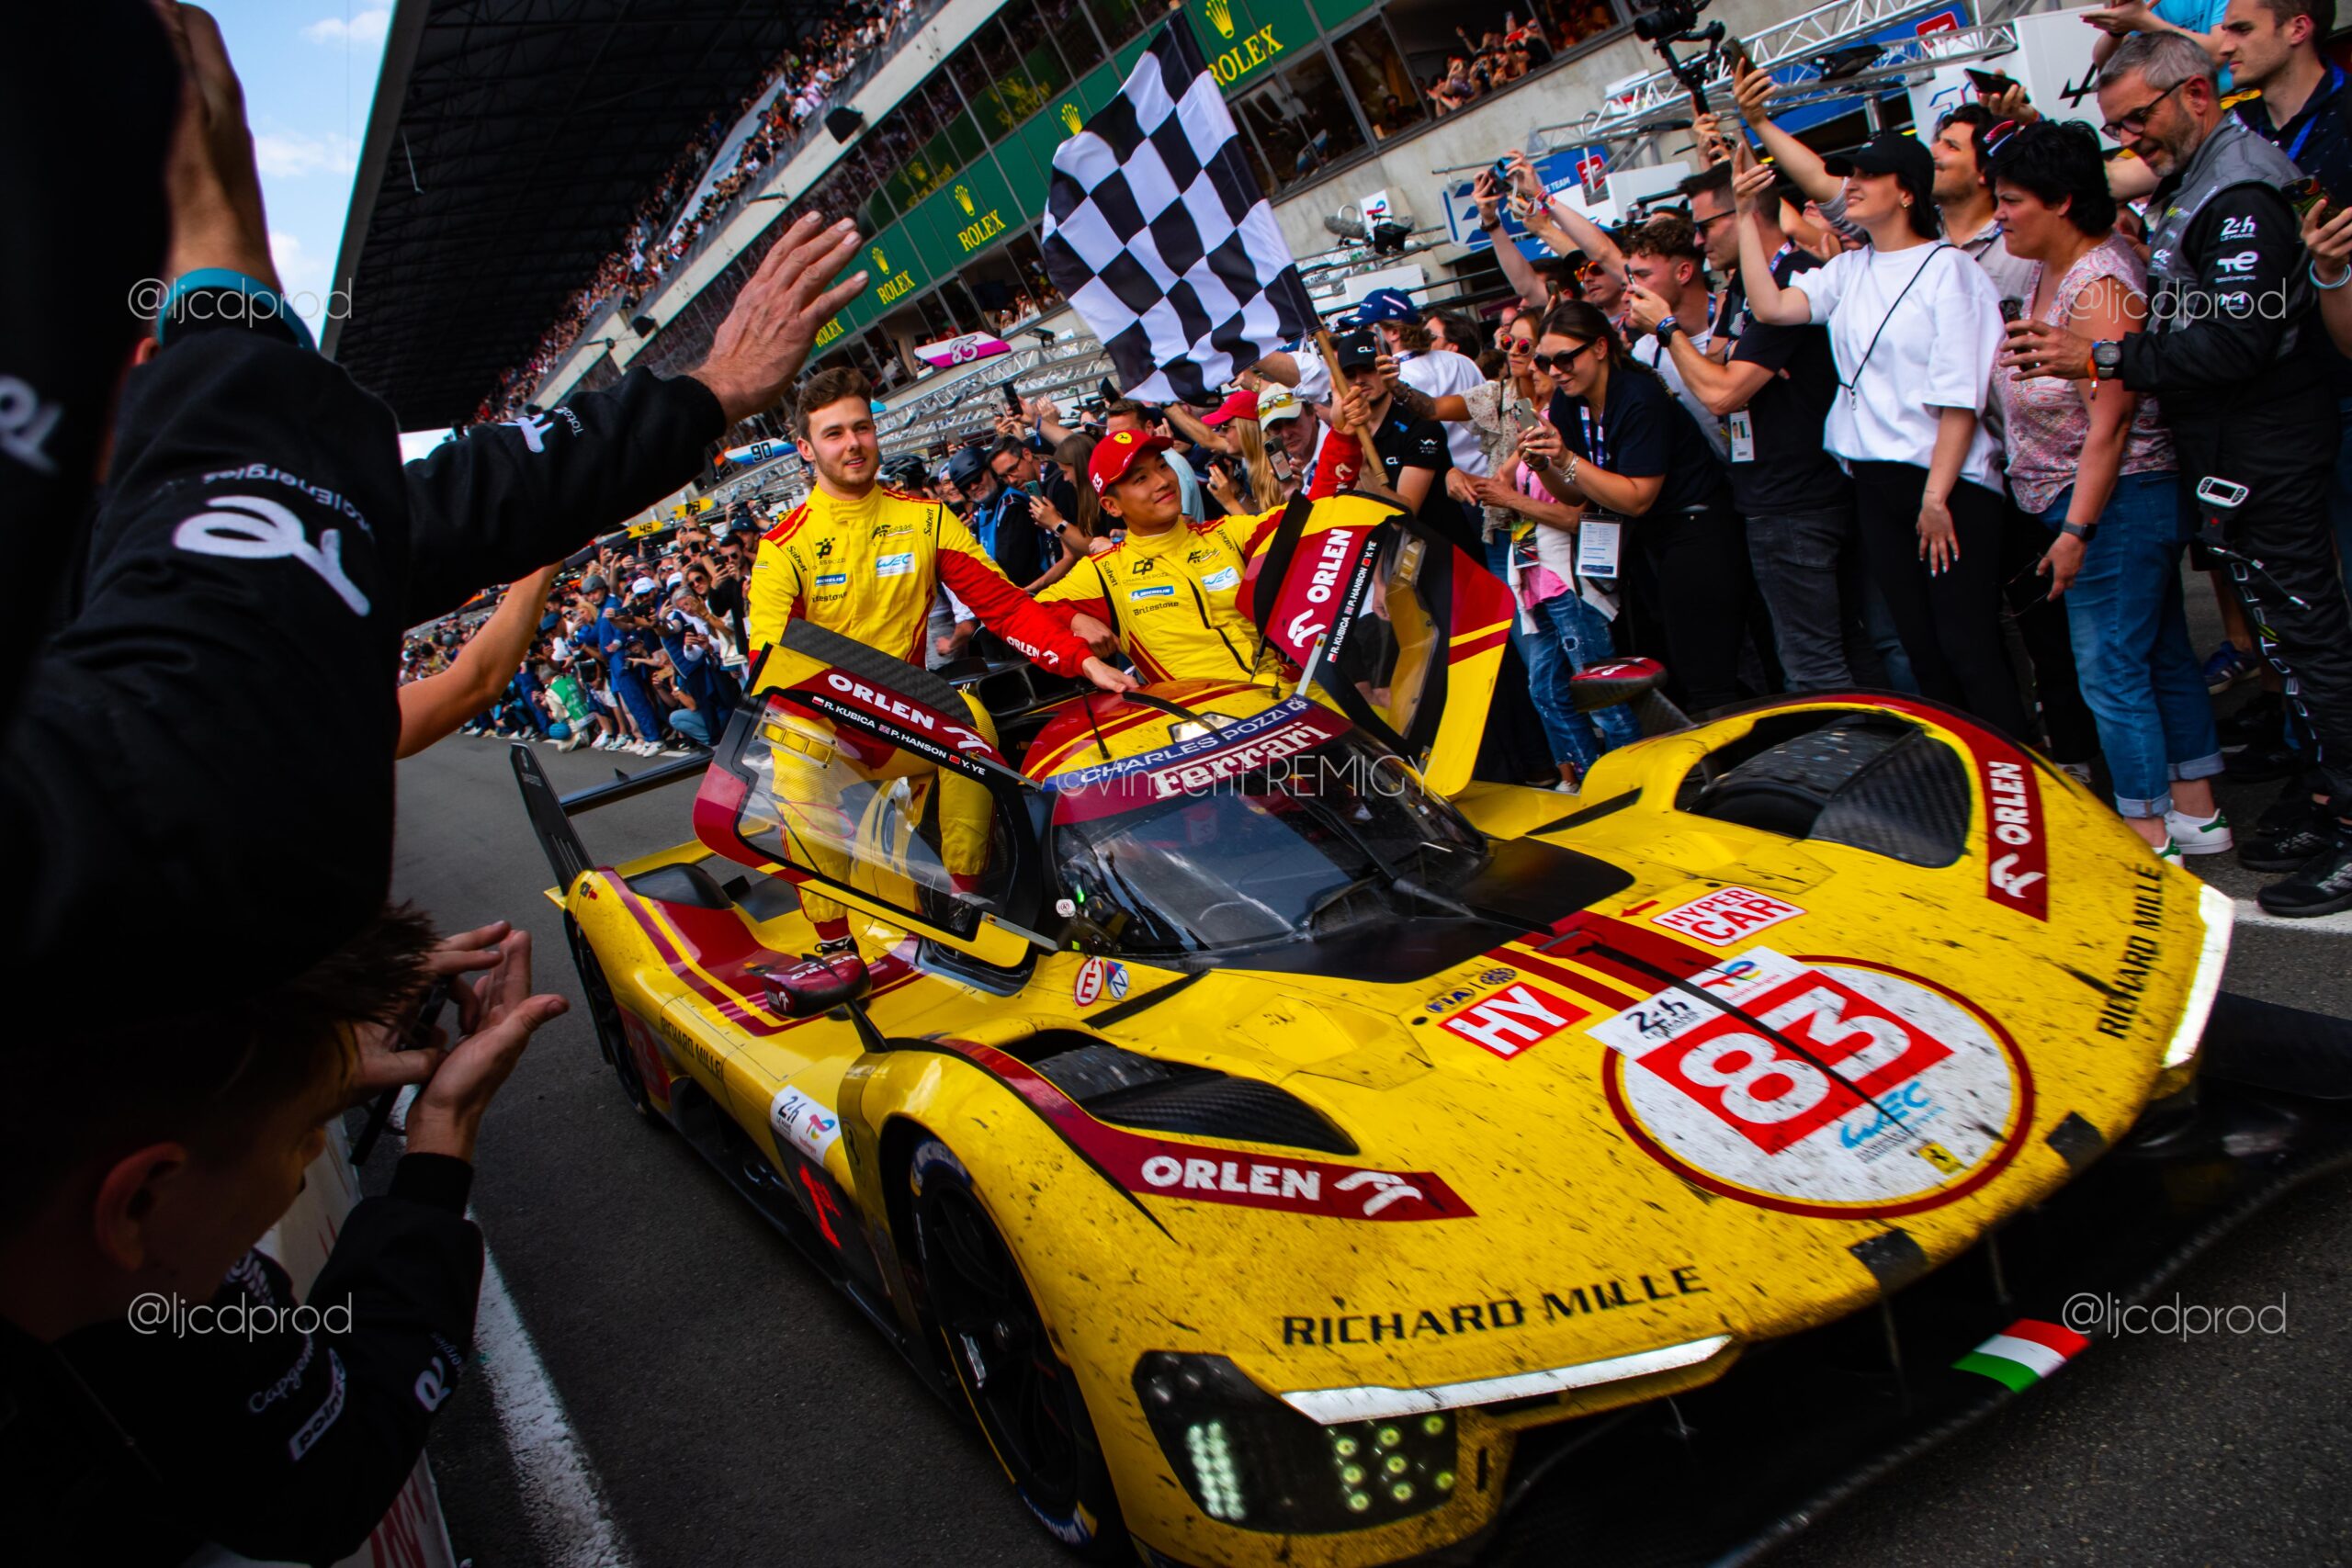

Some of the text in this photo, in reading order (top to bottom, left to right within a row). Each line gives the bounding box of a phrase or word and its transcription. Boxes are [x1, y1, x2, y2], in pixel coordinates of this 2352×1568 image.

[957, 209, 1006, 252] ROLEX
[876, 270, 915, 305] ROLEX
[949, 334, 978, 364] 85
[751, 442, 773, 461] 90
[1306, 528, 1353, 604] ORLEN
[1368, 540, 1377, 551] YE
[1350, 567, 1368, 597] HANSON
[1006, 636, 1040, 659] ORLEN
[1331, 643, 1340, 654] R.
[1334, 616, 1351, 643] KUBICA
[828, 673, 934, 730] ORLEN
[824, 701, 834, 711] R.
[835, 705, 876, 728] KUBICA
[890, 728, 900, 740] P.
[900, 734, 947, 759] HANSON
[971, 763, 987, 775] YE
[1080, 736, 1219, 784] CHARLES
[1226, 709, 1290, 741] POZZI
[1148, 721, 1333, 800] Ferrari
[1988, 761, 2032, 846] ORLEN
[1662, 889, 1756, 927] HYPER
[1690, 898, 1794, 941] CAR
[2097, 863, 2163, 1041] RICHARD MILLE
[1080, 972, 1096, 998] E
[1427, 990, 1472, 1013] FIA
[1446, 985, 1570, 1055] HY
[661, 1016, 694, 1057] RICHARD
[694, 1043, 723, 1077] MILLE
[1679, 987, 1913, 1125] 83
[1840, 1081, 1932, 1149] WEC
[1141, 1154, 1320, 1201] ORLEN
[1283, 1264, 1710, 1347] RICHARD MILLE
